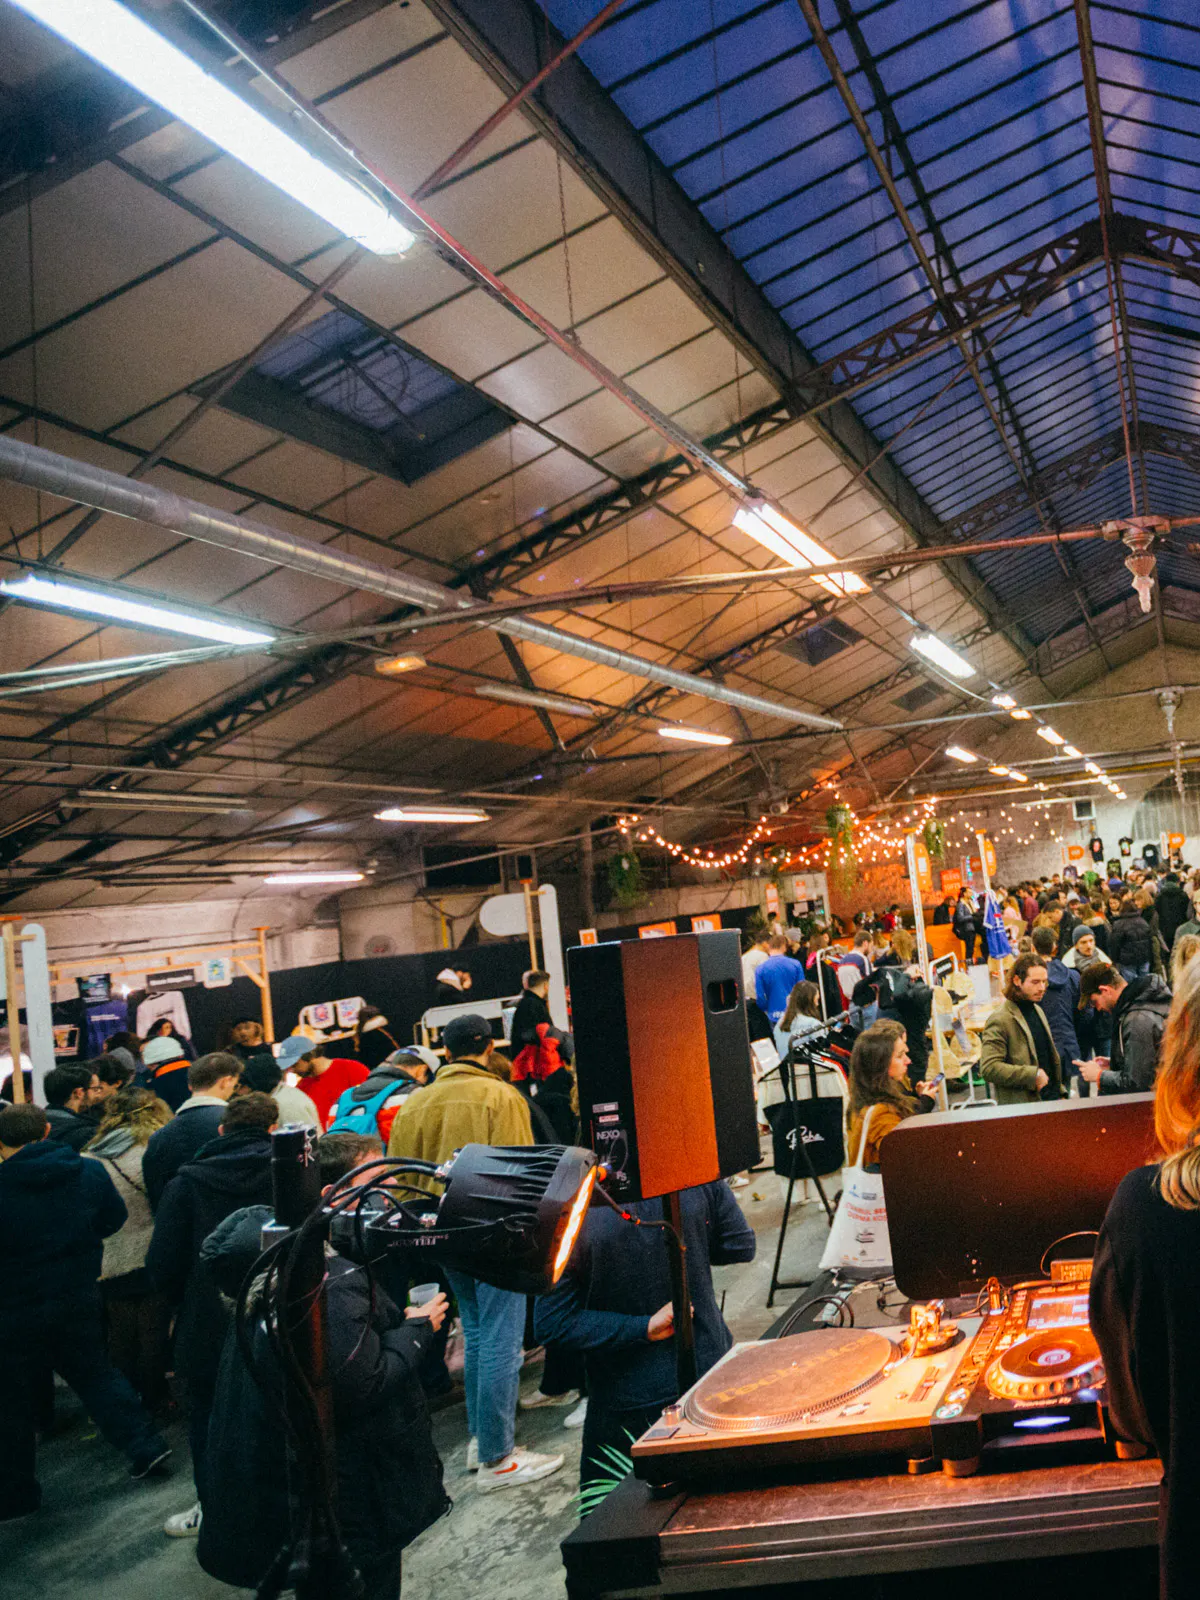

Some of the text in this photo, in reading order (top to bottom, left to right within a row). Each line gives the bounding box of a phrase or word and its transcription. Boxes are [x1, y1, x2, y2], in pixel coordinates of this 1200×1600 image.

[596, 1130, 620, 1140] NEXO
[706, 1334, 877, 1403] Technics
[1013, 1398, 1058, 1409] Pioneer
